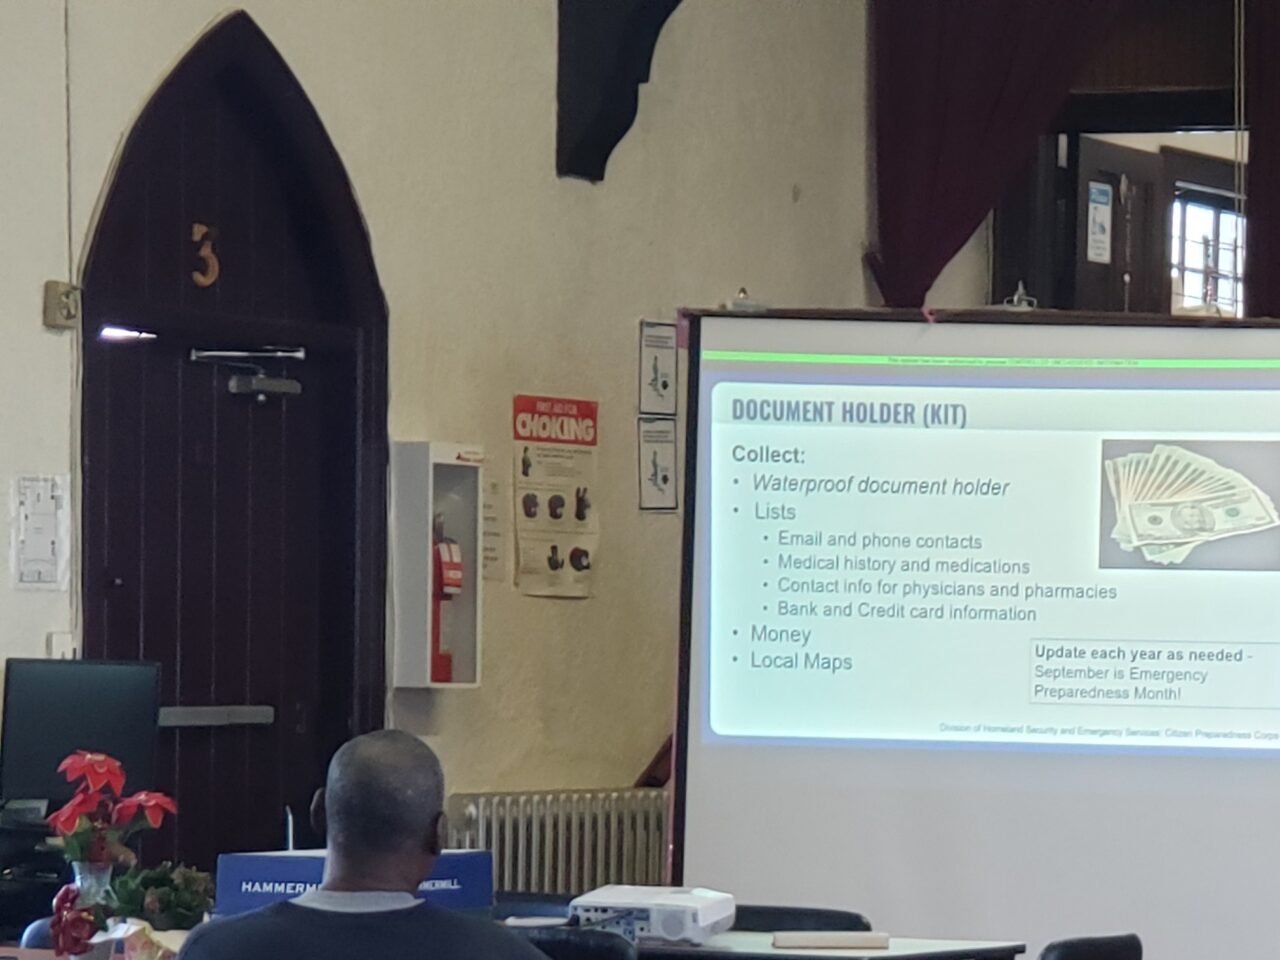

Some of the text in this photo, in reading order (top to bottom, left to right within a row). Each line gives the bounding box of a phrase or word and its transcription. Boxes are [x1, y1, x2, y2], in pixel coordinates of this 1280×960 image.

[192, 223, 219, 287] 3
[732, 399, 967, 429] DOCUMENT HOLDER (KIT)
[516, 412, 594, 442] CHOKING
[732, 445, 806, 464] Collect:
[753, 473, 1010, 496] Waterproof document holder
[755, 502, 796, 520] Lists
[778, 531, 983, 550] Email and phone contacts
[778, 555, 1030, 575] Medical history and medications
[778, 578, 1118, 602] Contact info for physicians and pharmacies
[778, 601, 1037, 622] Bank and Credit card information
[751, 626, 811, 646] Money
[751, 653, 853, 674] Local Maps
[1035, 645, 1086, 662] Update
[1091, 647, 1126, 660] each
[1130, 650, 1162, 663] year
[1166, 651, 1184, 661] as
[1189, 649, 1243, 662] needed
[1034, 665, 1208, 684] September is Emergency
[1034, 684, 1181, 701] Preparedness Month!
